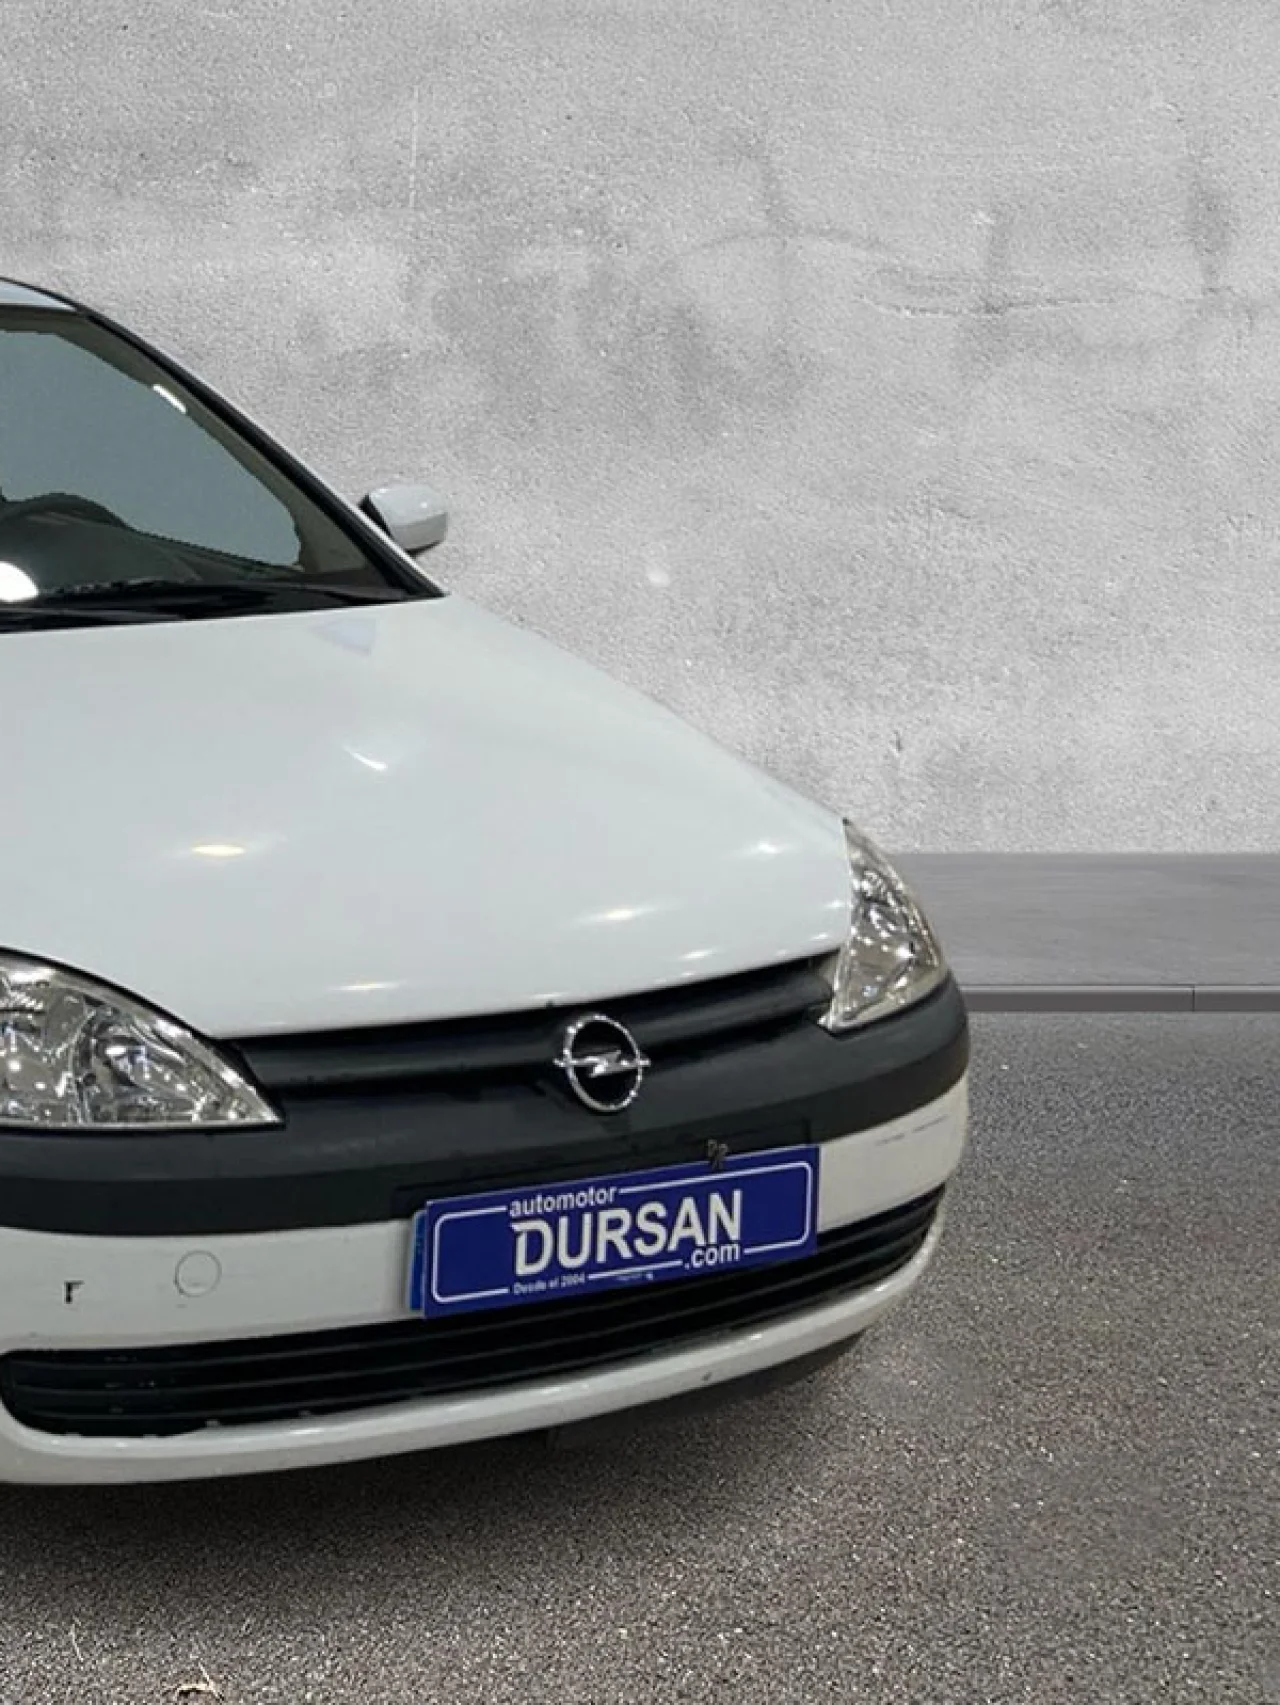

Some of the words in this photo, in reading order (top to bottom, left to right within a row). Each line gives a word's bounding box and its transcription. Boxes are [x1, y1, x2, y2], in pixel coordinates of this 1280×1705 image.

[509, 1186, 617, 1217] automotor
[510, 1189, 743, 1275] DURSAN
[684, 1243, 741, 1270] .com
